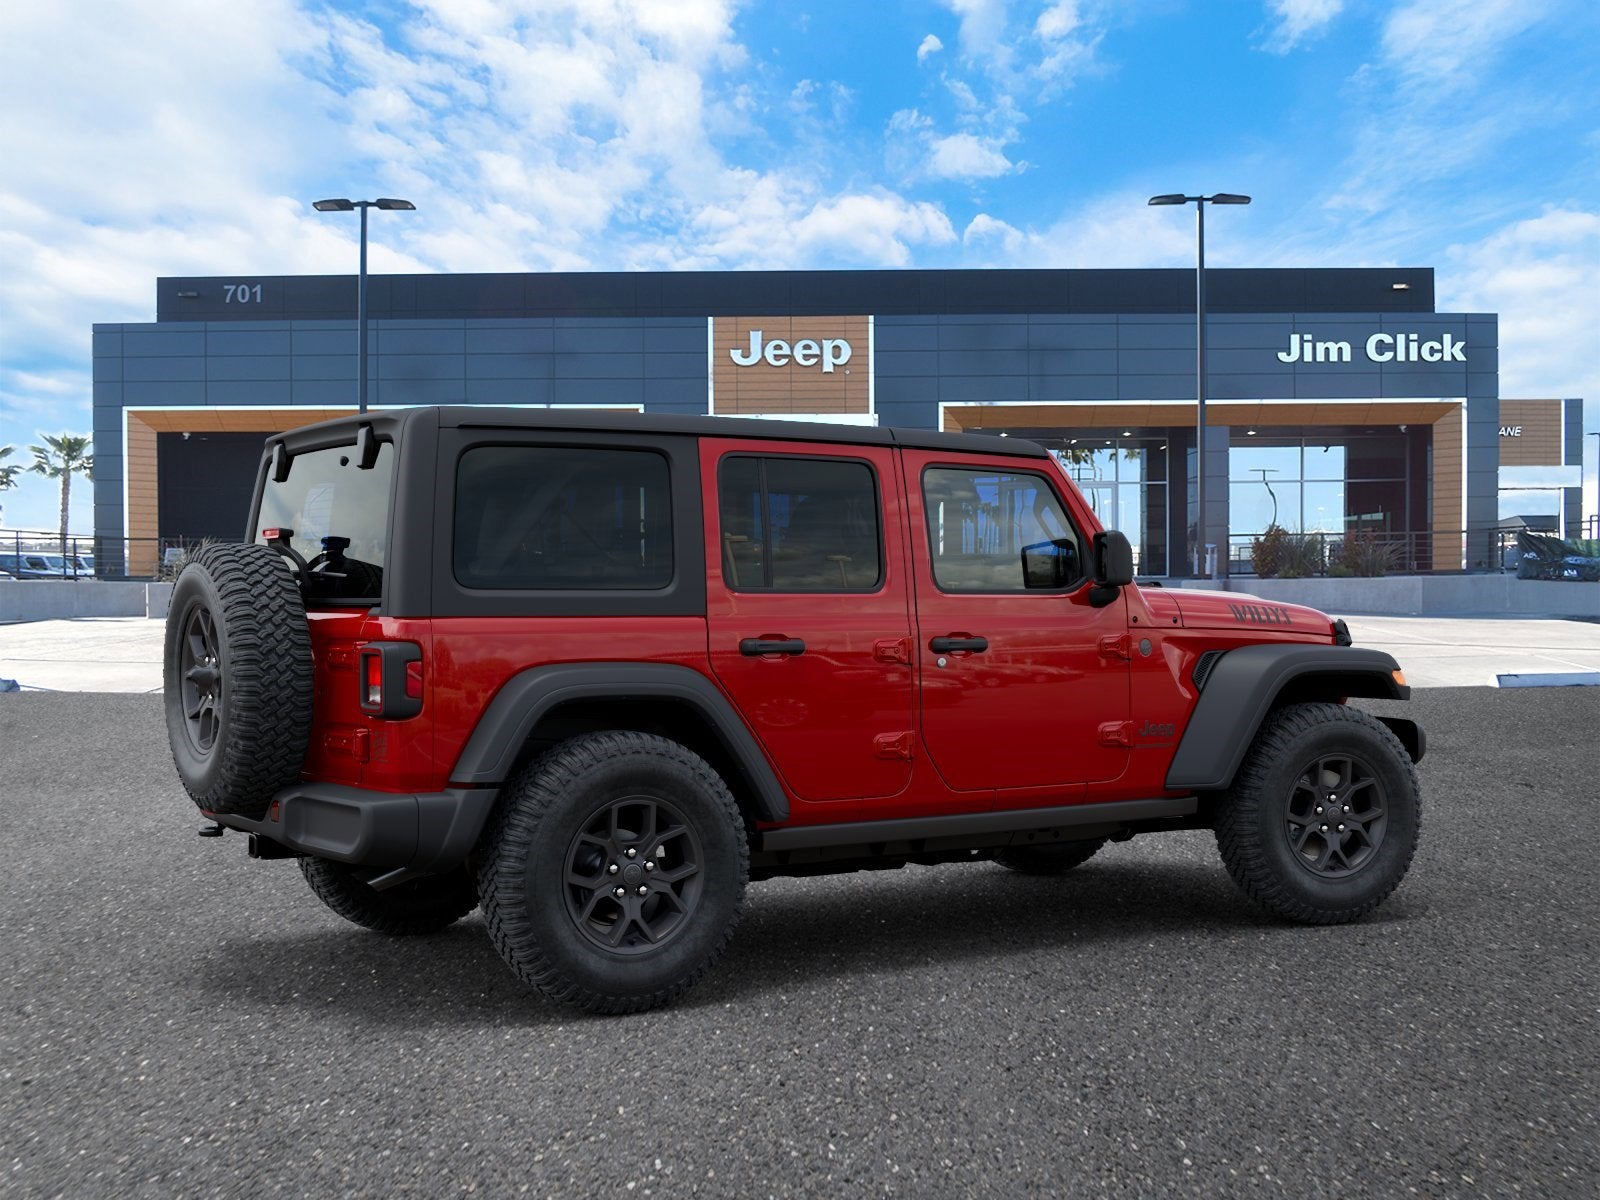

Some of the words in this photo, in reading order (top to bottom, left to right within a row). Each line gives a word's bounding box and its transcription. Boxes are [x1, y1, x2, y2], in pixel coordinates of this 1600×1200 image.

[223, 284, 262, 304] 701
[729, 329, 852, 374] Jeep
[1277, 333, 1352, 363] Jim
[1366, 333, 1467, 363] Click
[1498, 426, 1523, 437] ANE
[1227, 604, 1292, 625] WILLYS
[1138, 719, 1176, 740] Jeep
